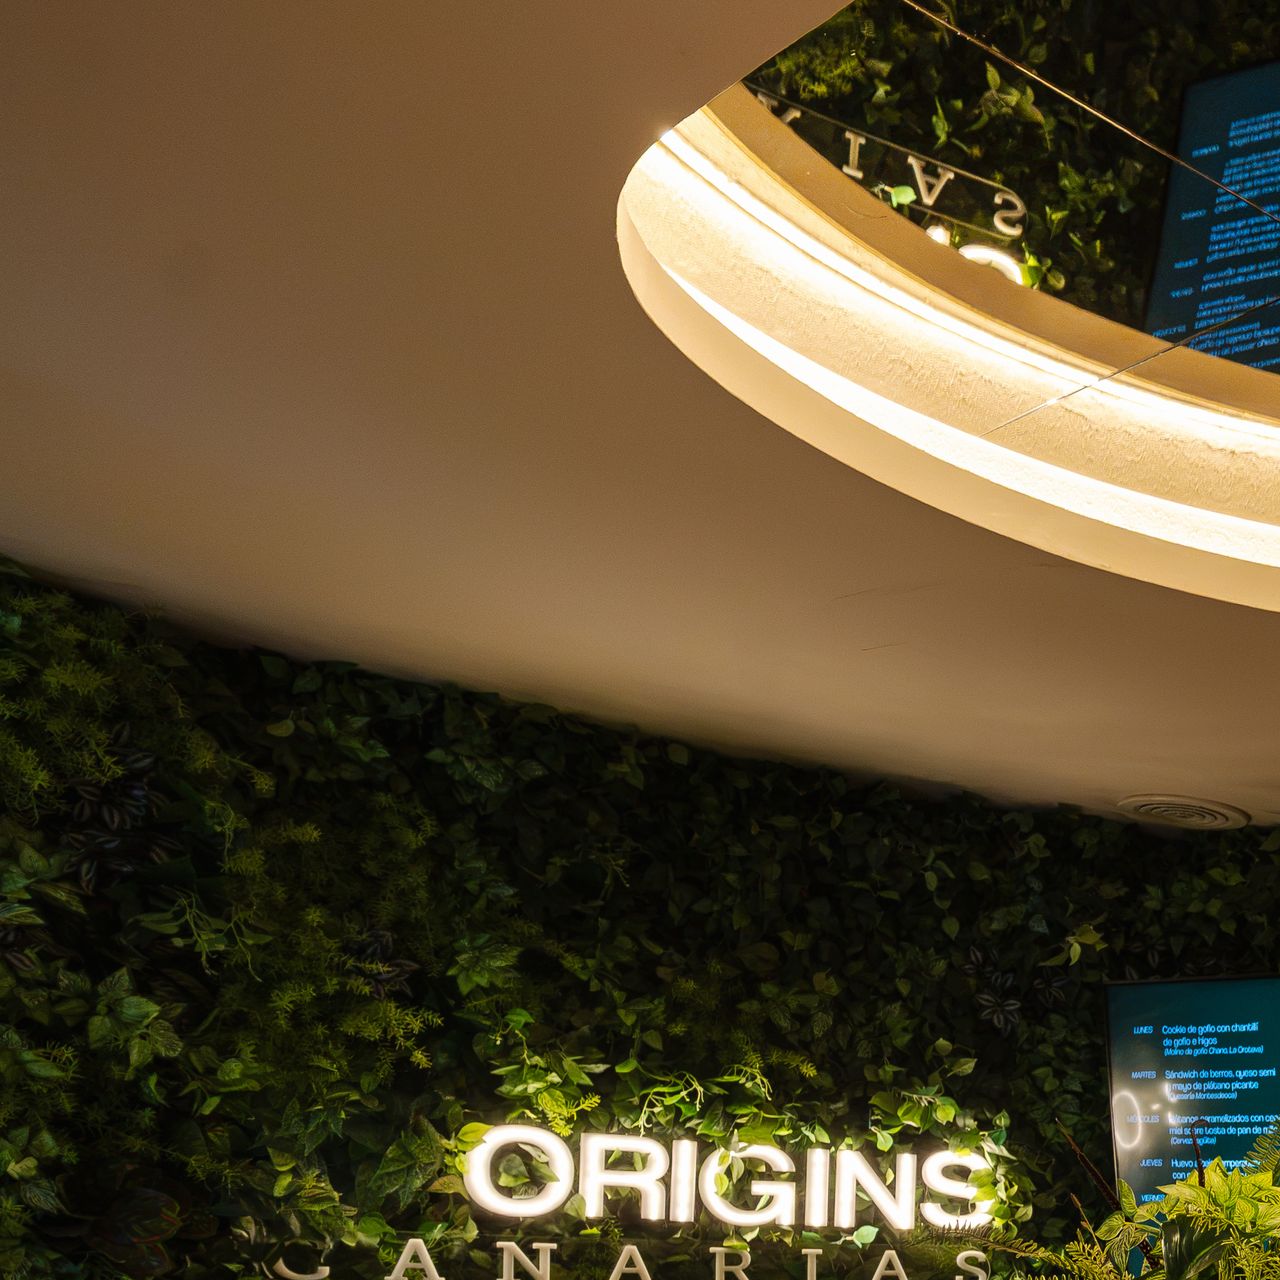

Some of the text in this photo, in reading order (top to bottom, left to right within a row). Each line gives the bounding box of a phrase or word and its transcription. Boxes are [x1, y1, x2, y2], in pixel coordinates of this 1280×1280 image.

[1134, 1025, 1154, 1034] LUNES
[1162, 1024, 1186, 1034] Cookie
[1187, 1024, 1197, 1033] de
[1198, 1023, 1215, 1035] gofio
[1217, 1024, 1230, 1033] con
[1163, 1037, 1173, 1046] de
[1174, 1036, 1190, 1047] gofio
[1132, 1071, 1157, 1079] MARTES
[1200, 1069, 1209, 1078] de
[1236, 1069, 1258, 1079] queso
[1173, 1083, 1192, 1092] mayo
[1193, 1082, 1202, 1090] de
[1203, 1081, 1230, 1092] plátano
[1232, 1080, 1259, 1091] picante
[1251, 1114, 1264, 1123] con
[1169, 1126, 1183, 1135] miel
[1227, 1125, 1236, 1134] de
[1237, 1126, 1251, 1136] pan
[1252, 1125, 1261, 1134] de
[1140, 1159, 1163, 1167] JUEVES
[1171, 1159, 1194, 1167] Huevo
[464, 1124, 995, 1230] ORIGINS
